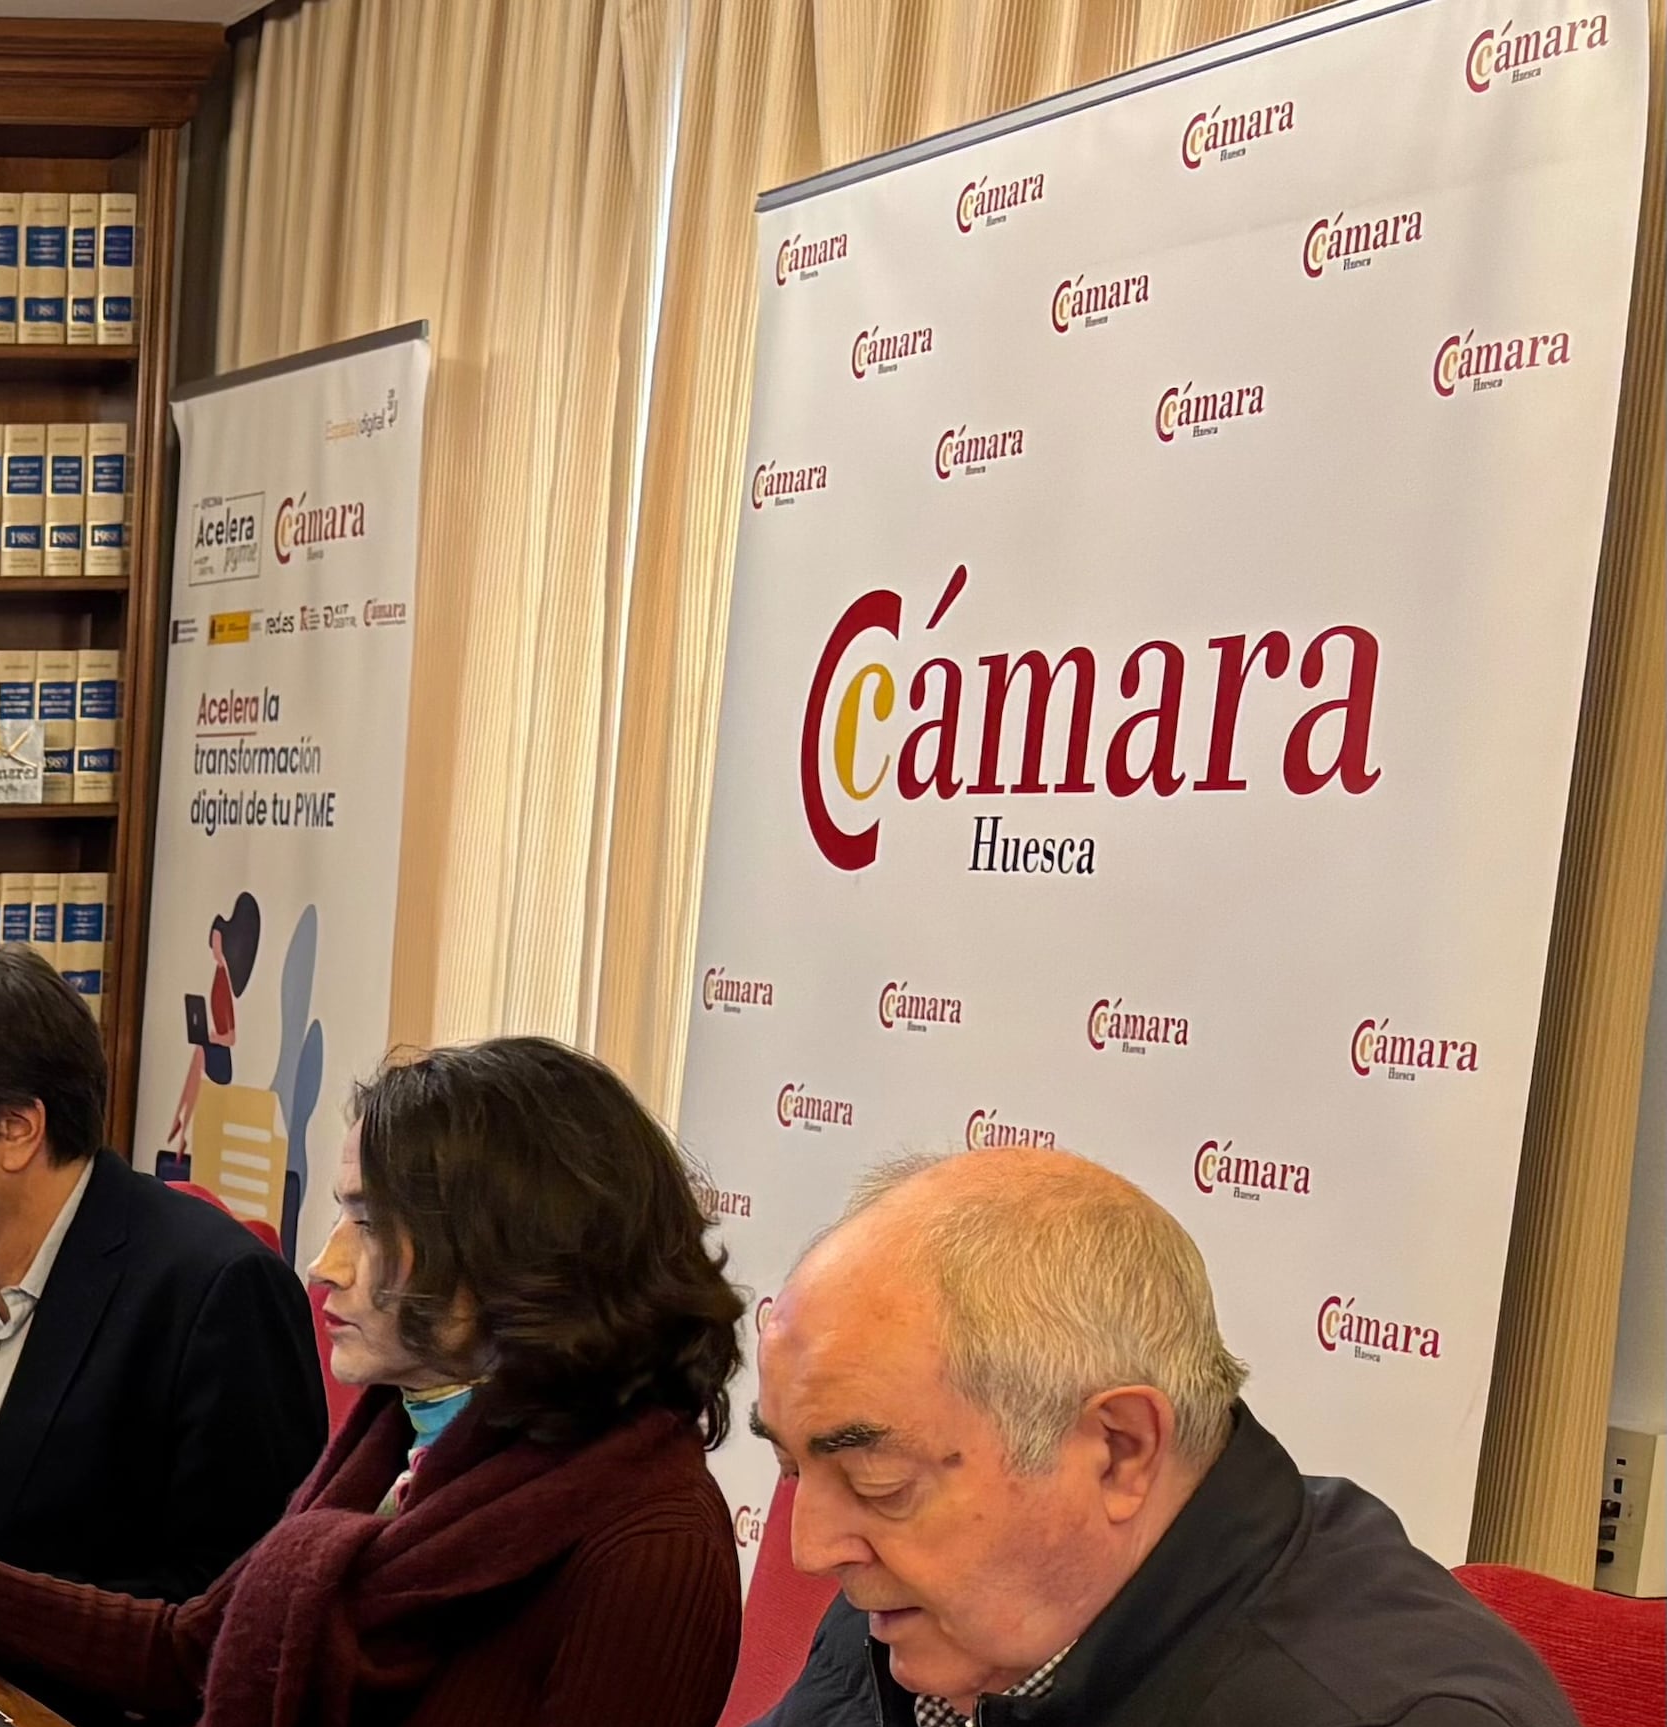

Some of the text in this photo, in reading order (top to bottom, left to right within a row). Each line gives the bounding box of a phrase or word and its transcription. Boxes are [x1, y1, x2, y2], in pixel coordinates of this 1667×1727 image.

[1466, 11, 1609, 93] Cámara
[1512, 68, 1542, 84] Huesca
[1182, 99, 1294, 169] Cámara
[957, 168, 1045, 234] Cámara
[777, 228, 849, 286] Cámara
[1303, 209, 1422, 278] Cámara
[1343, 256, 1371, 272] Huesca
[1051, 269, 1149, 334] Cámara
[852, 322, 933, 381] Cámara
[1434, 330, 1571, 397] Cámara
[1156, 382, 1265, 443] Cámara
[1473, 378, 1502, 394] Huesca
[936, 426, 1024, 480] Cámara
[752, 459, 828, 509] Cámara
[195, 507, 254, 549] Acelera
[275, 491, 364, 564] Cámara
[197, 687, 279, 726] Acelera la
[801, 565, 1382, 870] Cámara
[194, 737, 321, 777] transformación
[190, 791, 336, 836] digital de tu PYME
[969, 816, 1096, 875] Huesca
[703, 967, 773, 1009] Cámara
[879, 982, 962, 1029] Cámara
[1087, 998, 1189, 1052] Cámara
[1351, 1019, 1479, 1077] Cámara
[777, 1083, 853, 1127] Cámara
[1194, 1139, 1311, 1195] Cámara
[1318, 1295, 1440, 1359] Cámara
